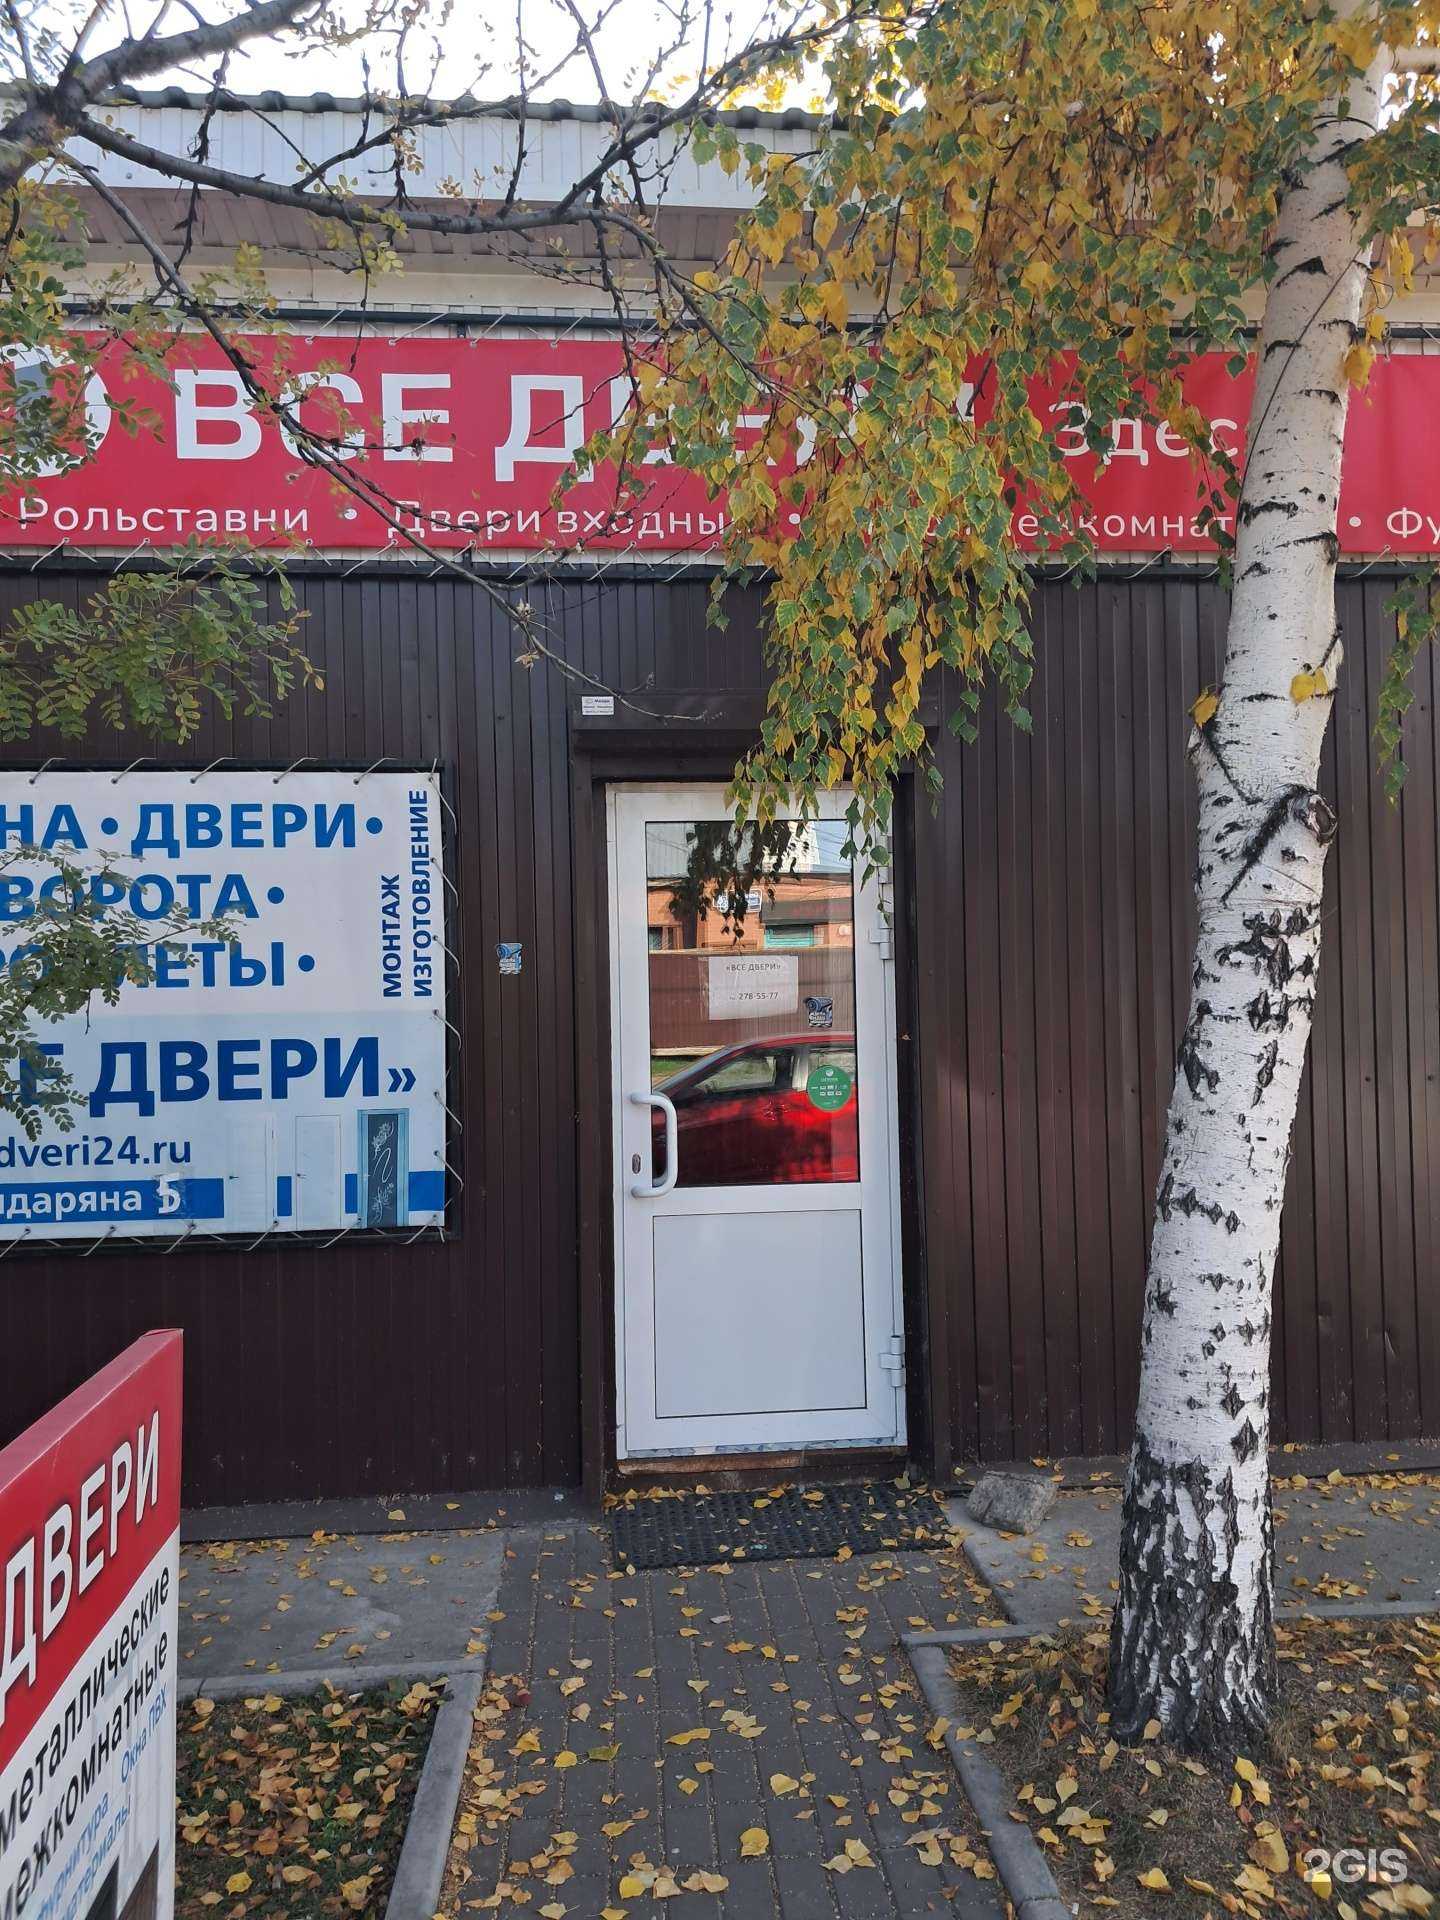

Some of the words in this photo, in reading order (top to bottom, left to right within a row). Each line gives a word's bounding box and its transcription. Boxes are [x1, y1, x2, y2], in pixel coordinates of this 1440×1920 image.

[175, 369, 453, 463] ВСЕ
[19, 497, 308, 532] Рольставни
[387, 500, 540, 540] Двери
[557, 509, 751, 540] входны
[131, 803, 356, 859] ДВЕРИ
[0, 874, 260, 921] ВОРОТА
[408, 790, 432, 997] ИЗГОТОВЛЕНИЕ
[380, 874, 401, 998] МОНТАЖ
[738, 992, 779, 1001] 278-55-77
[89, 1036, 416, 1118] ДВЕРИ»
[0, 1135, 192, 1168] dveri24.ru
[0, 1189, 142, 1221] даряна
[0, 1411, 159, 1726] ДВЕРИ
[121, 1726, 147, 1783] Окна
